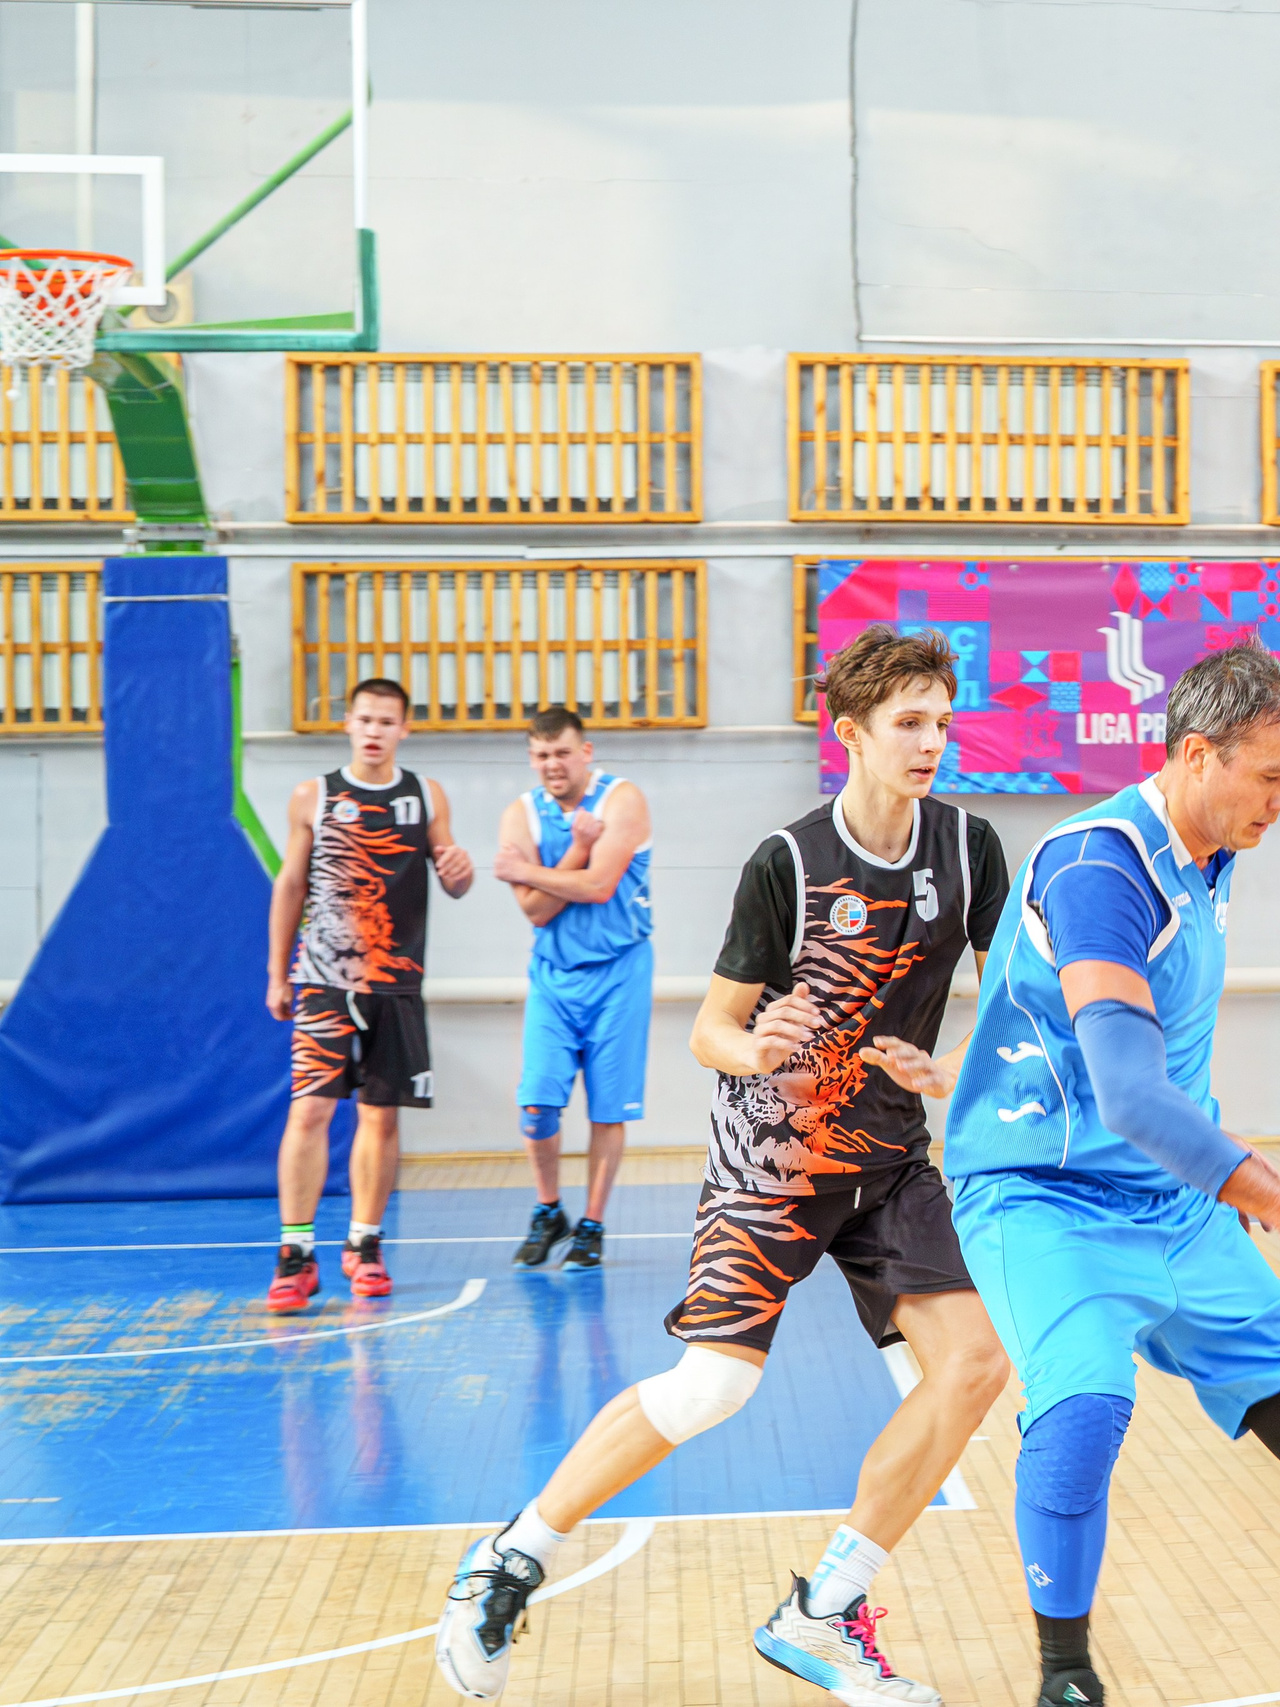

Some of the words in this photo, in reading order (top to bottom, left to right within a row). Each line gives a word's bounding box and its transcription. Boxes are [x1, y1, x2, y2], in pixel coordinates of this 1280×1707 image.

[1076, 713, 1133, 744] LIGA
[1137, 713, 1167, 743] PR
[912, 868, 939, 922] 5
